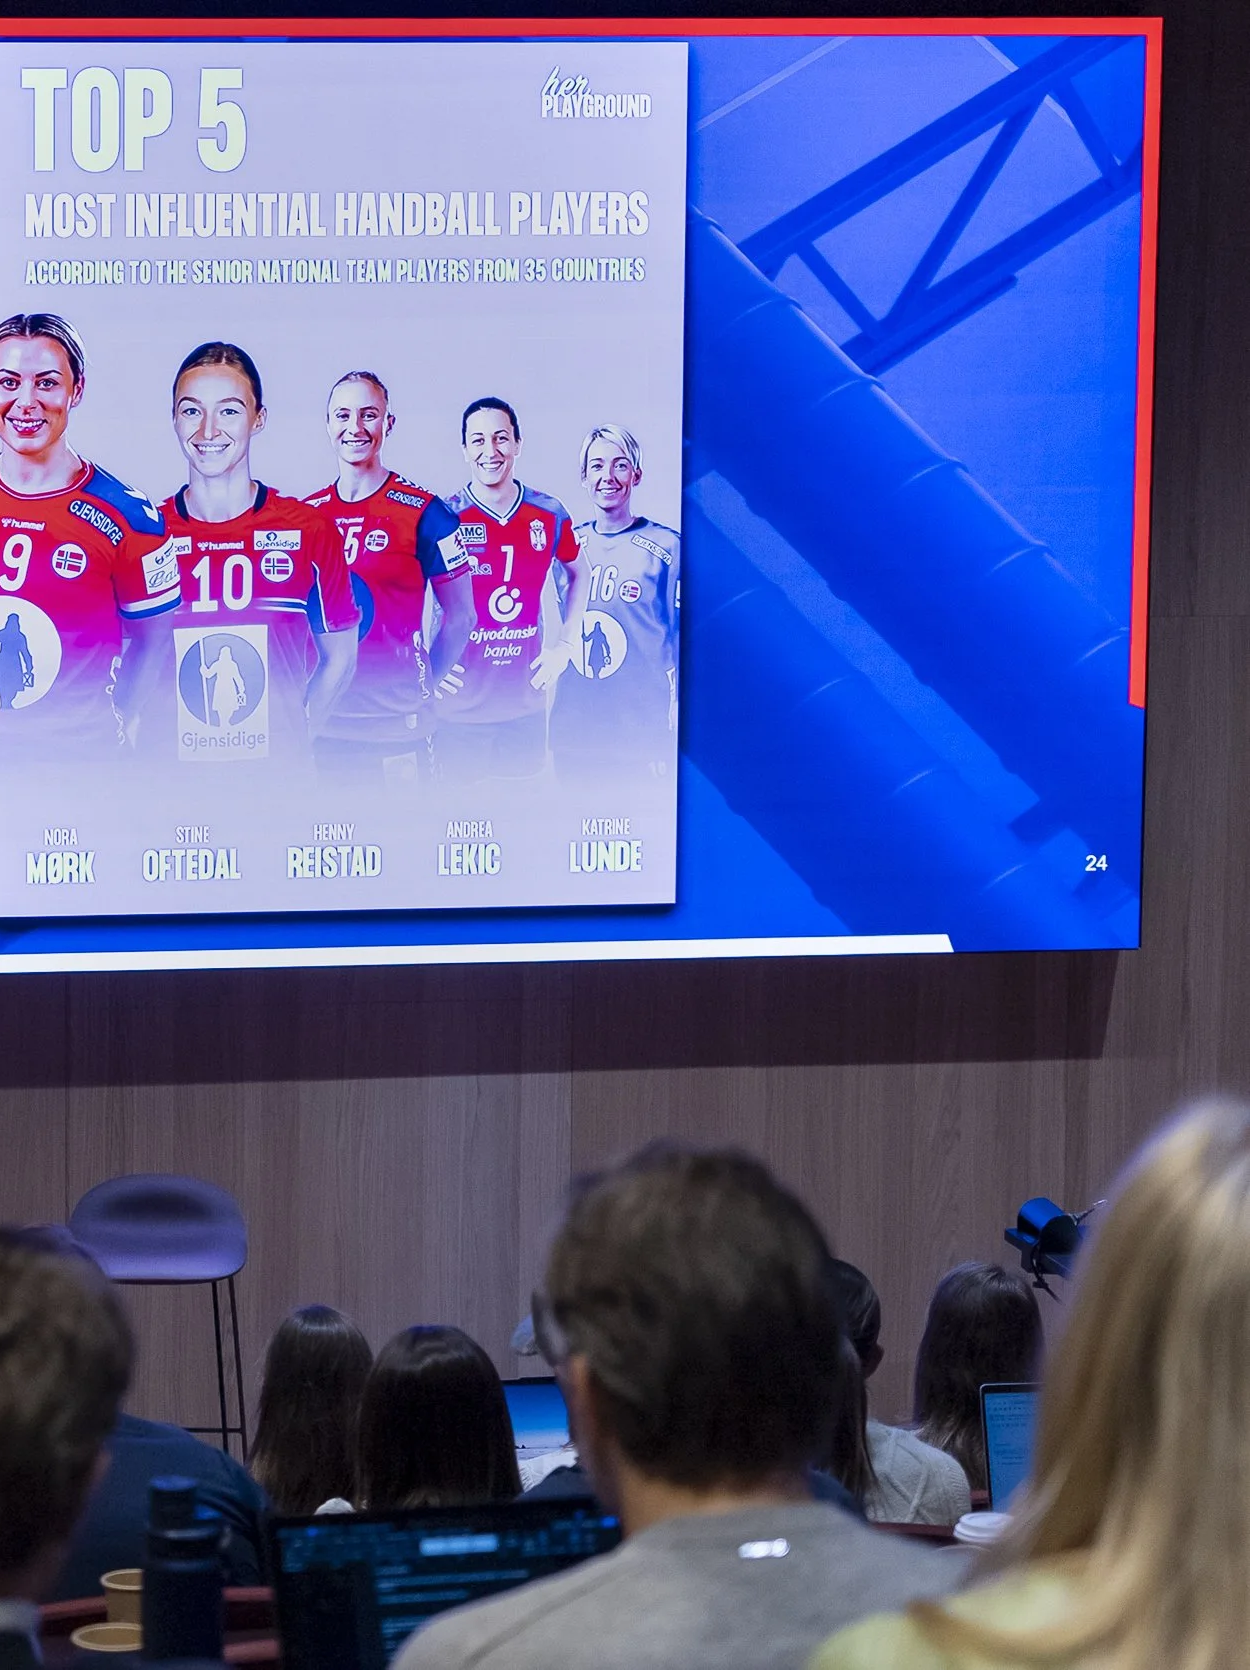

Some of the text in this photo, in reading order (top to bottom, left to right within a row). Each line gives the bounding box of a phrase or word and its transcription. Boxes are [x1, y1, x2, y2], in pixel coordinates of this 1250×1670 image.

[541, 65, 591, 97] her
[21, 66, 247, 173] TOP 5
[541, 93, 652, 118] PLAYGROUND
[24, 189, 649, 238] MOST INFLUENTIAL HANDBALL PLAYERS
[24, 256, 646, 284] ACCORDING TO THE SENIOR NATIONAL TEAM PLAYERS FROM 35 COUNTRIES
[69, 499, 124, 546] GJENSIDIGE
[255, 540, 300, 550] Gjensidige
[501, 545, 514, 582] 7
[191, 554, 253, 612] 10
[589, 564, 619, 602] 16
[484, 643, 523, 658] banka
[181, 731, 266, 752] Gjensidige
[44, 828, 78, 846] NORA
[174, 825, 210, 845] STINE
[313, 823, 355, 841] HENNY
[446, 820, 493, 839] ANDREA
[581, 817, 631, 836] KATRINE
[26, 851, 96, 885] MØRK
[141, 847, 241, 883] OFTEDAL
[287, 844, 383, 879] REISTAD
[437, 842, 502, 876] LEKIC
[569, 839, 643, 873] LUNDE
[1084, 854, 1108, 872] 24
